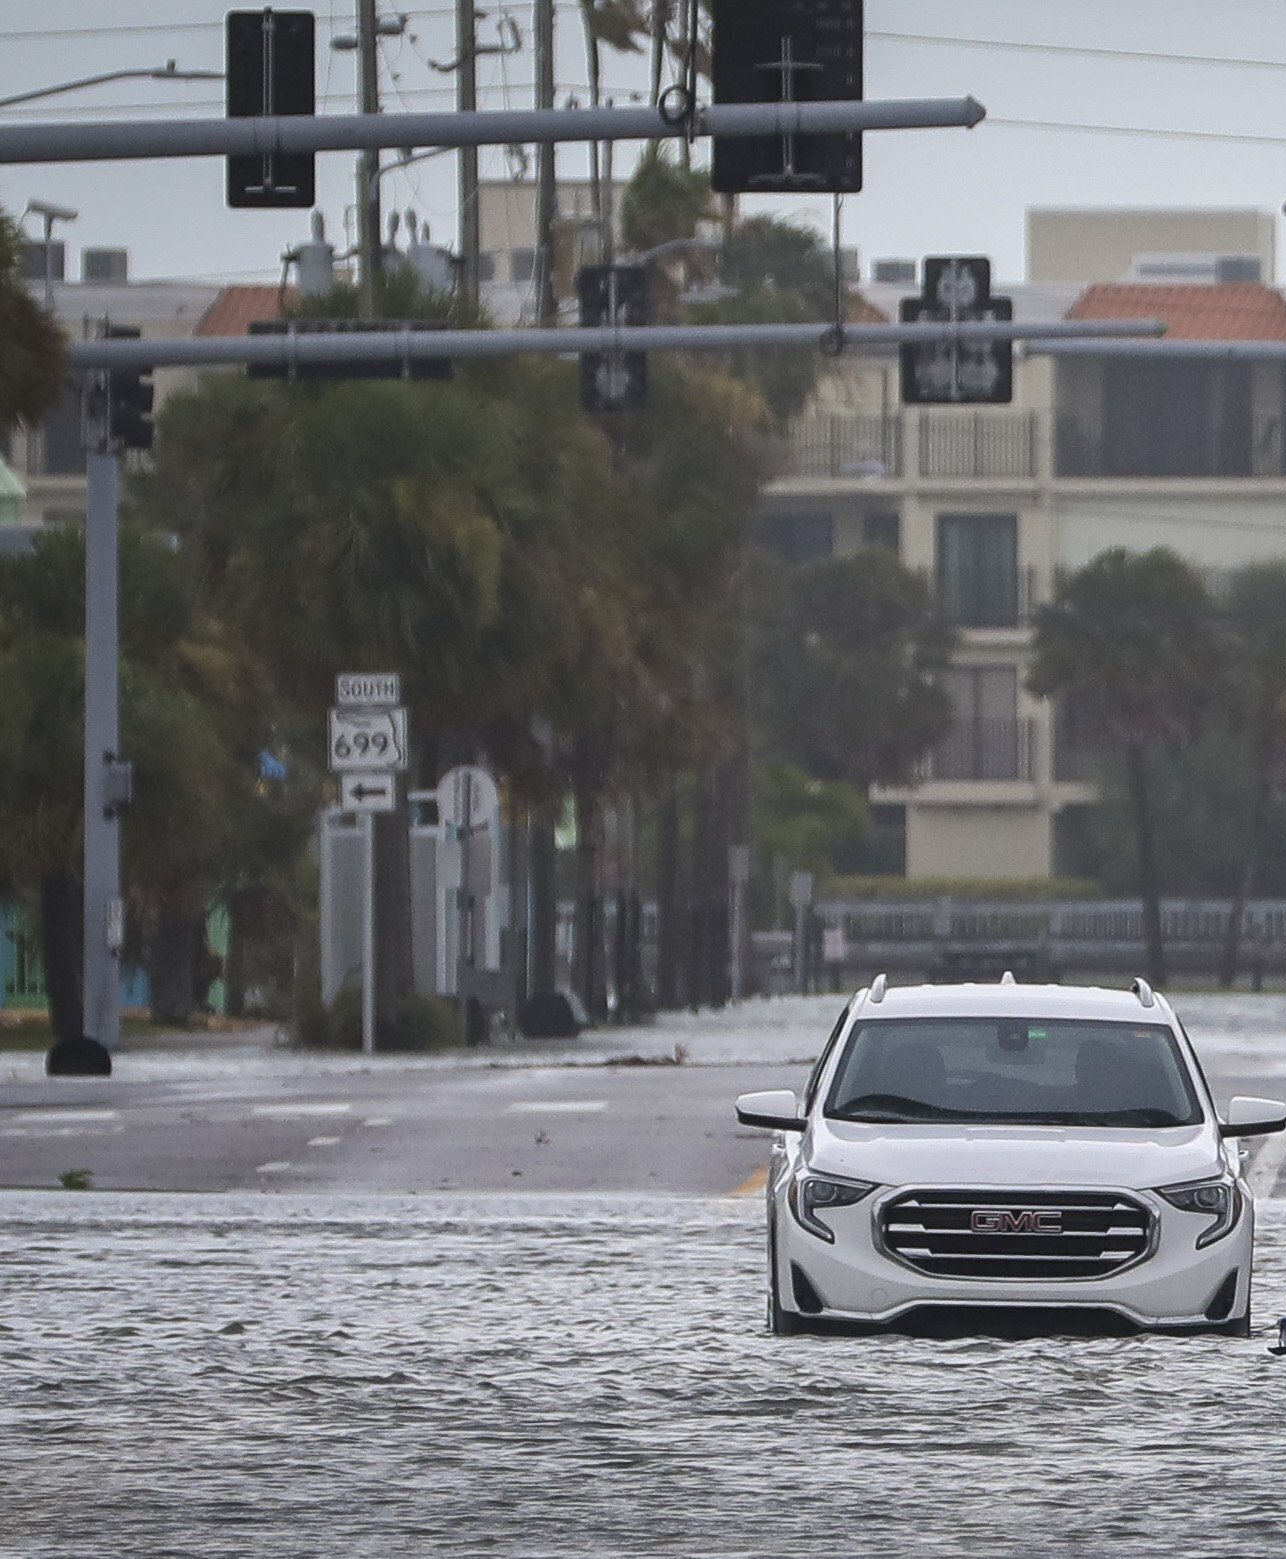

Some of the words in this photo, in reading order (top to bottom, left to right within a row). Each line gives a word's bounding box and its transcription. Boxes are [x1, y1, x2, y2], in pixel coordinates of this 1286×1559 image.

[340, 680, 395, 697] SOUTH
[334, 732, 388, 758] 699
[971, 1211, 1062, 1233] GMC
